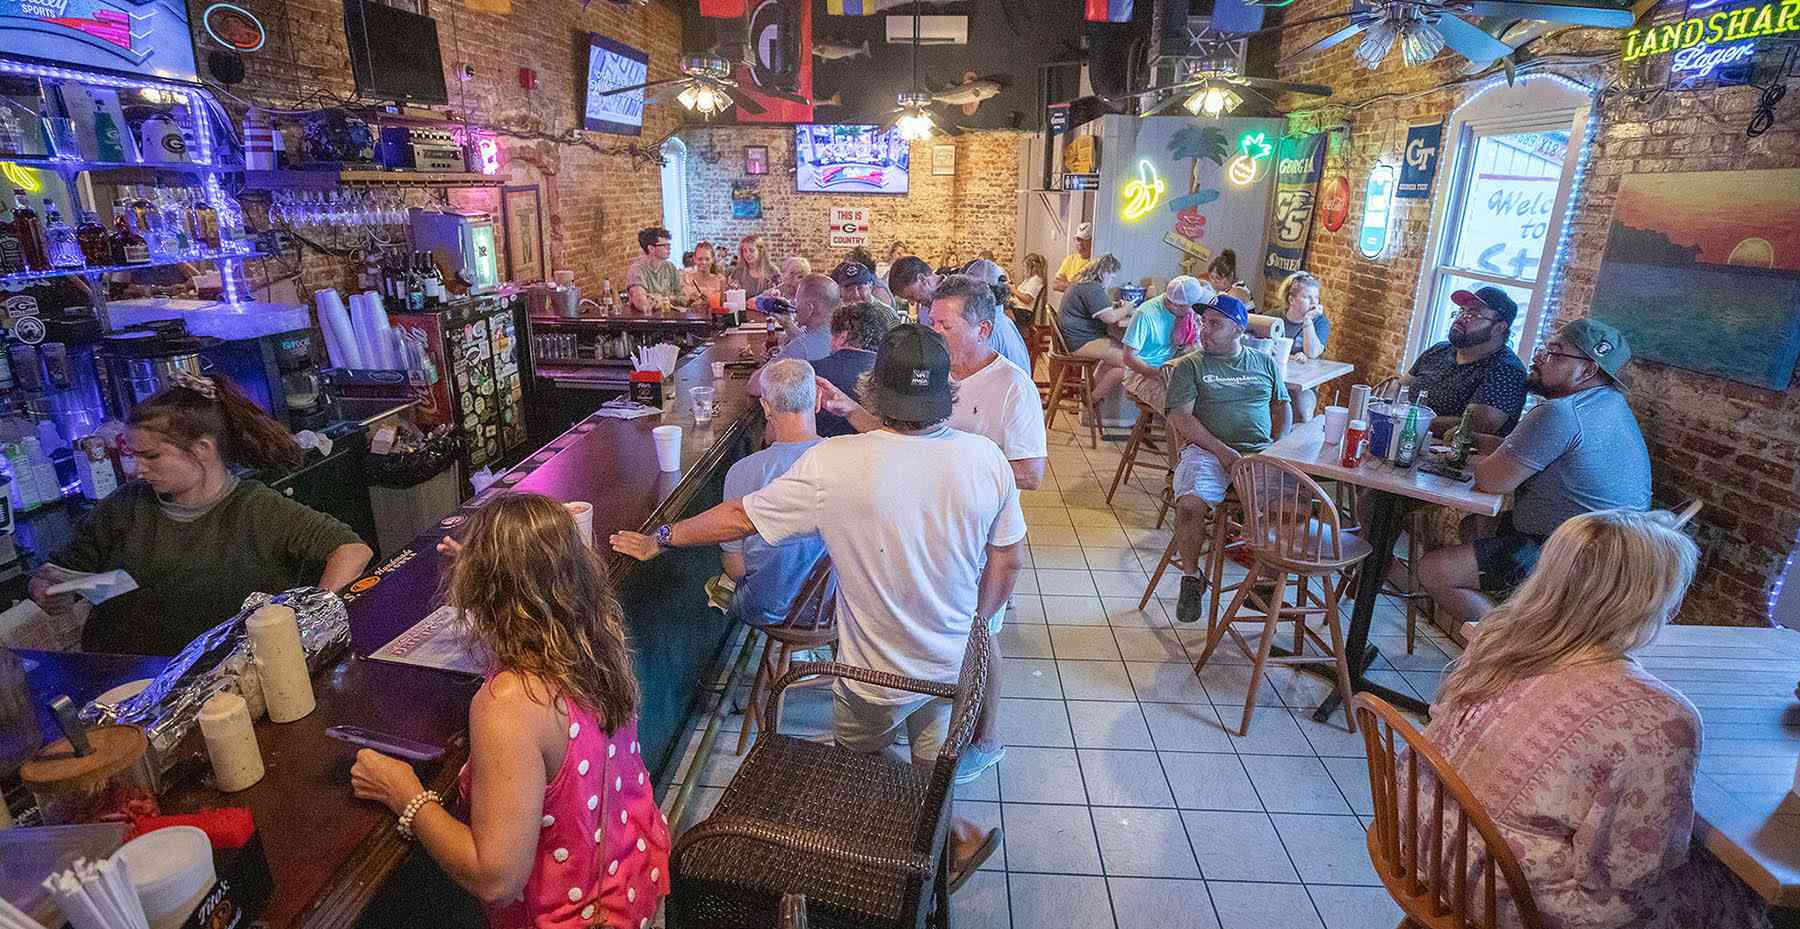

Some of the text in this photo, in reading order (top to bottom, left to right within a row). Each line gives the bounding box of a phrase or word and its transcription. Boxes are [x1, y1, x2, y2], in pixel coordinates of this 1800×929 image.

[21, 3, 57, 18] SPORTS
[1671, 41, 1755, 76] Lager
[1406, 138, 1435, 171] GT
[1279, 155, 1315, 175] GEORGIA
[837, 210, 863, 221] THIS IS
[842, 223, 857, 233] G
[833, 236, 866, 245] COUNTRY
[1202, 374, 1258, 385] Champion
